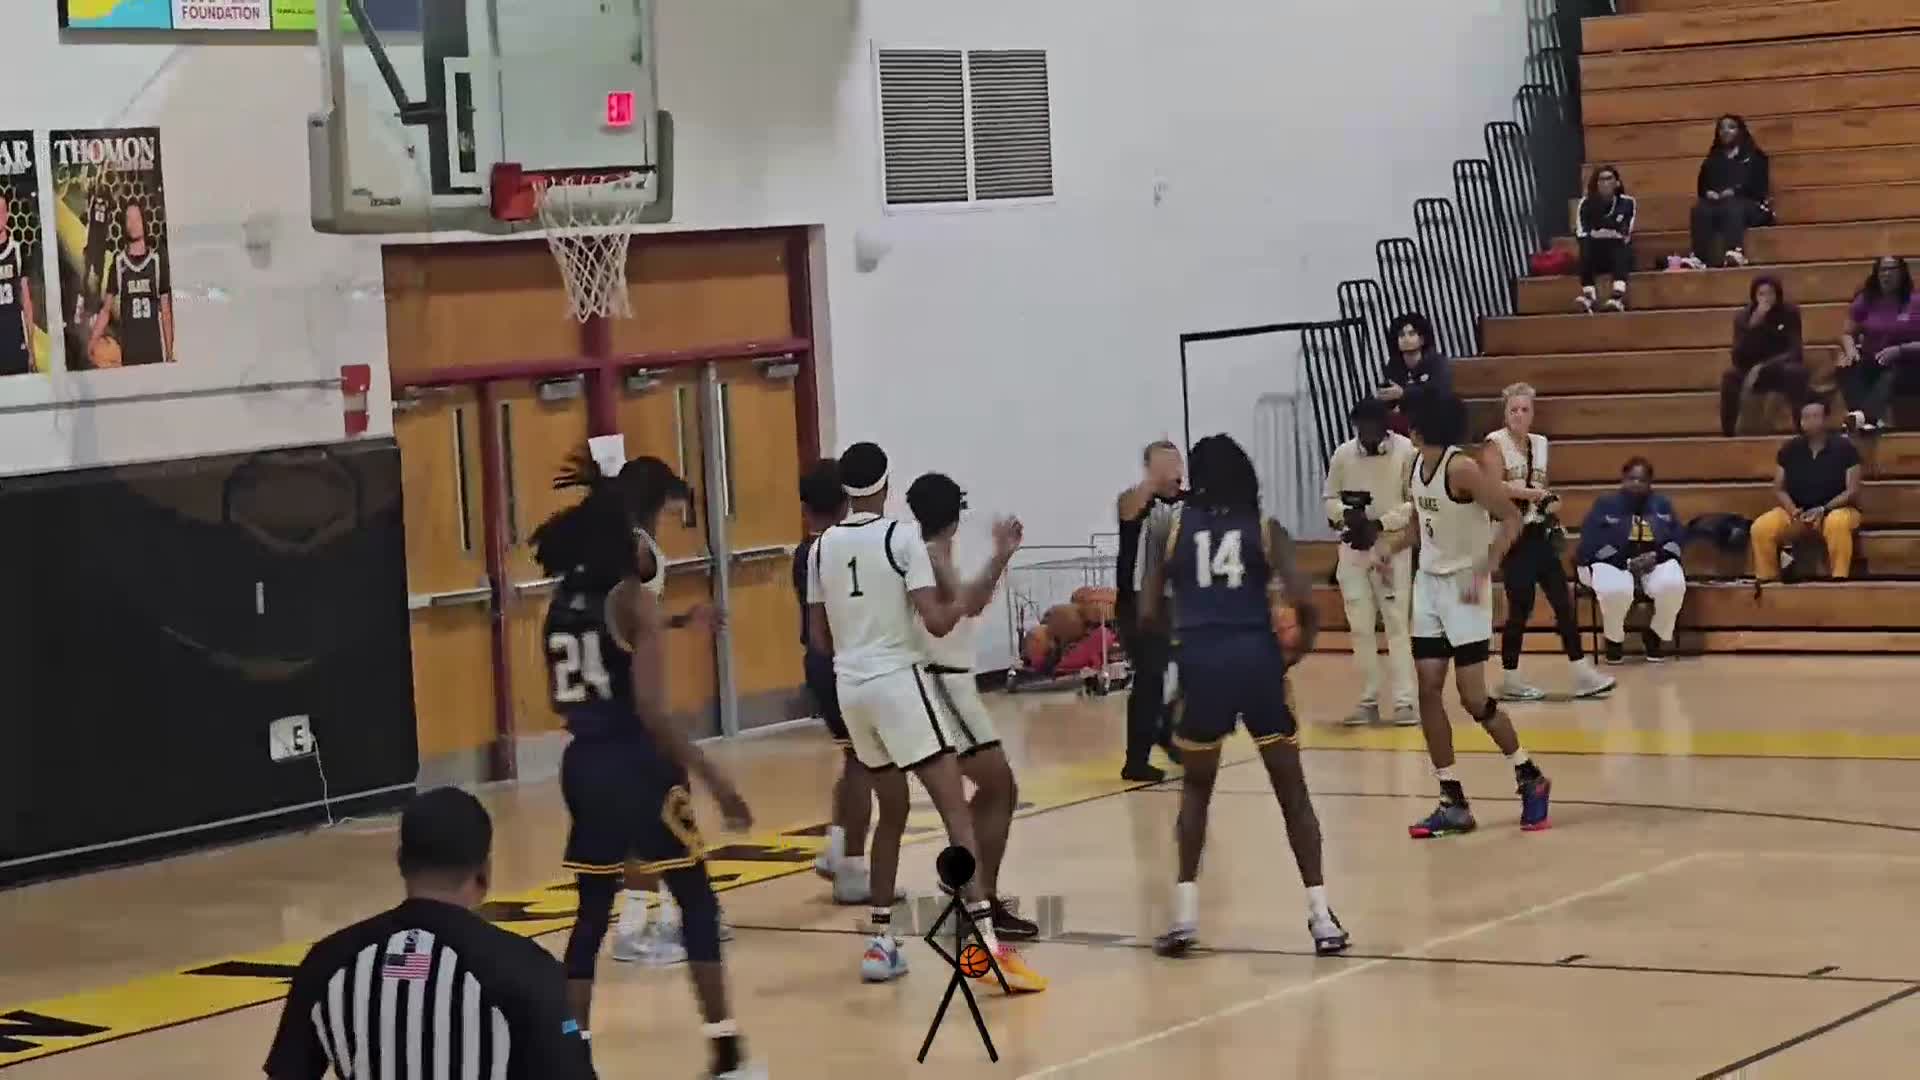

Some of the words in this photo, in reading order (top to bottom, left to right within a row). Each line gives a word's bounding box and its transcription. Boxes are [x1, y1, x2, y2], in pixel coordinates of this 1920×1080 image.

[182, 6, 260, 19] FOUNDATION
[54, 137, 155, 165] THOMON
[848, 556, 864, 597] 1
[1193, 529, 1245, 589] 14
[549, 631, 613, 702] 24
